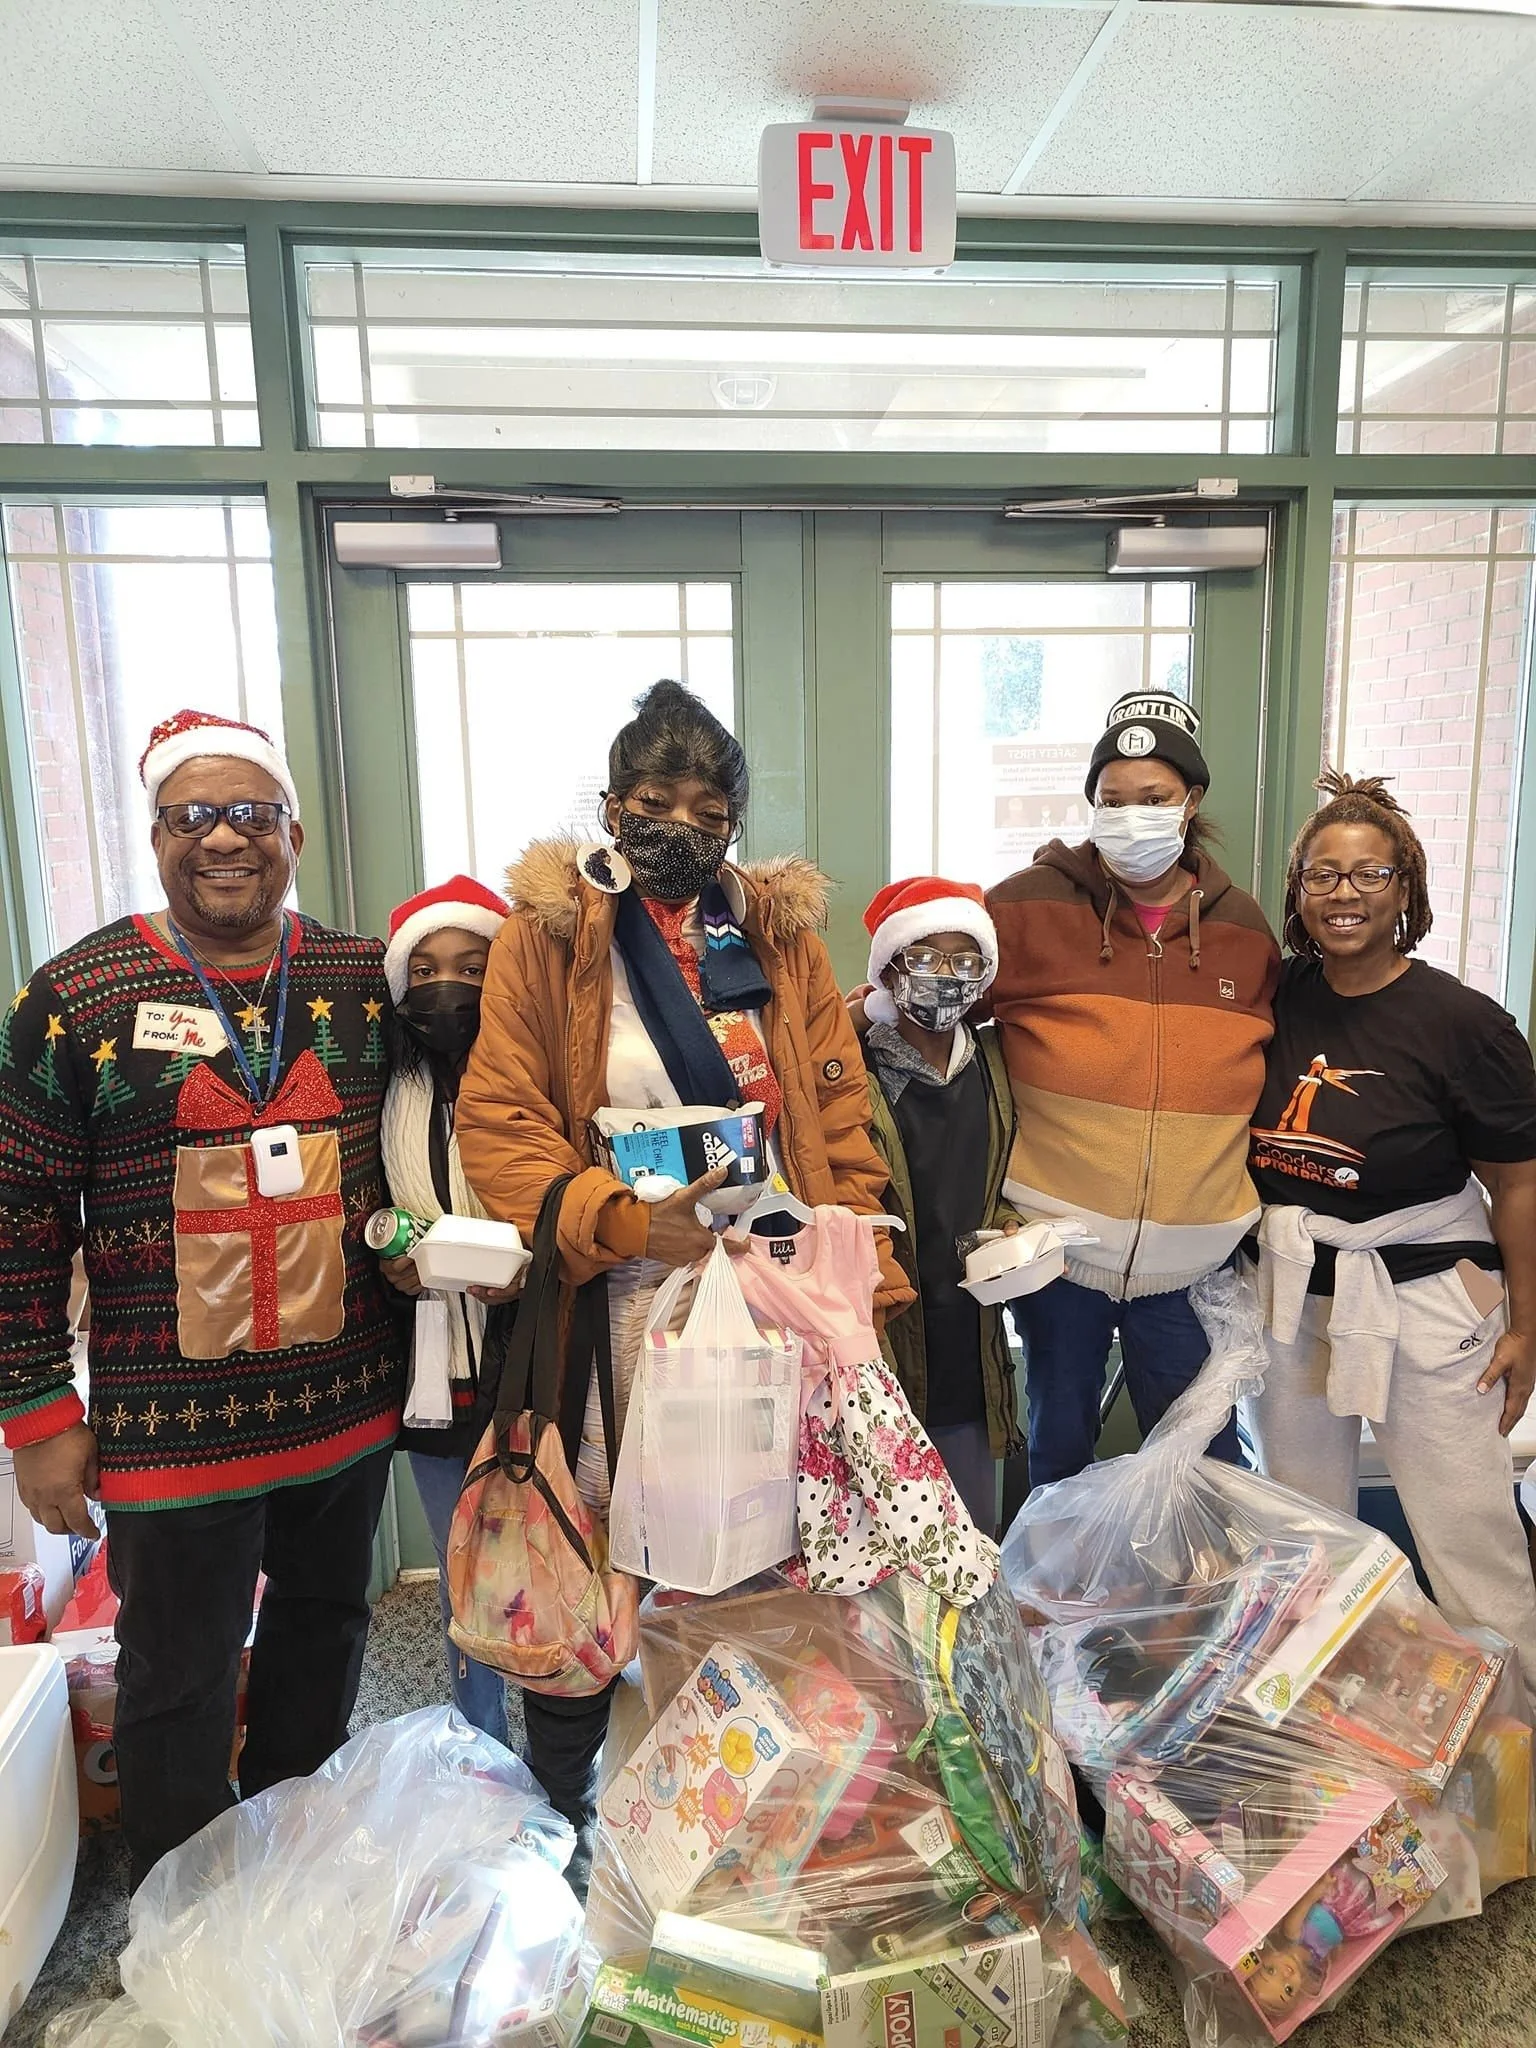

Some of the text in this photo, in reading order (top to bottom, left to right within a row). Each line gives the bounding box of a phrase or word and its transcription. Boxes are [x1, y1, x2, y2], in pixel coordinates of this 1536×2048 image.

[797, 133, 933, 253] EXIT
[143, 1028, 206, 1048] FROM: Me
[146, 1011, 165, 1021] TO:
[702, 1131, 719, 1172] adida
[71, 1537, 91, 1566] Foa
[1339, 1549, 1393, 1615] AIR POPPER SET
[1386, 1833, 1423, 1883] Fairyland
[633, 1985, 738, 2036] Mathematics
